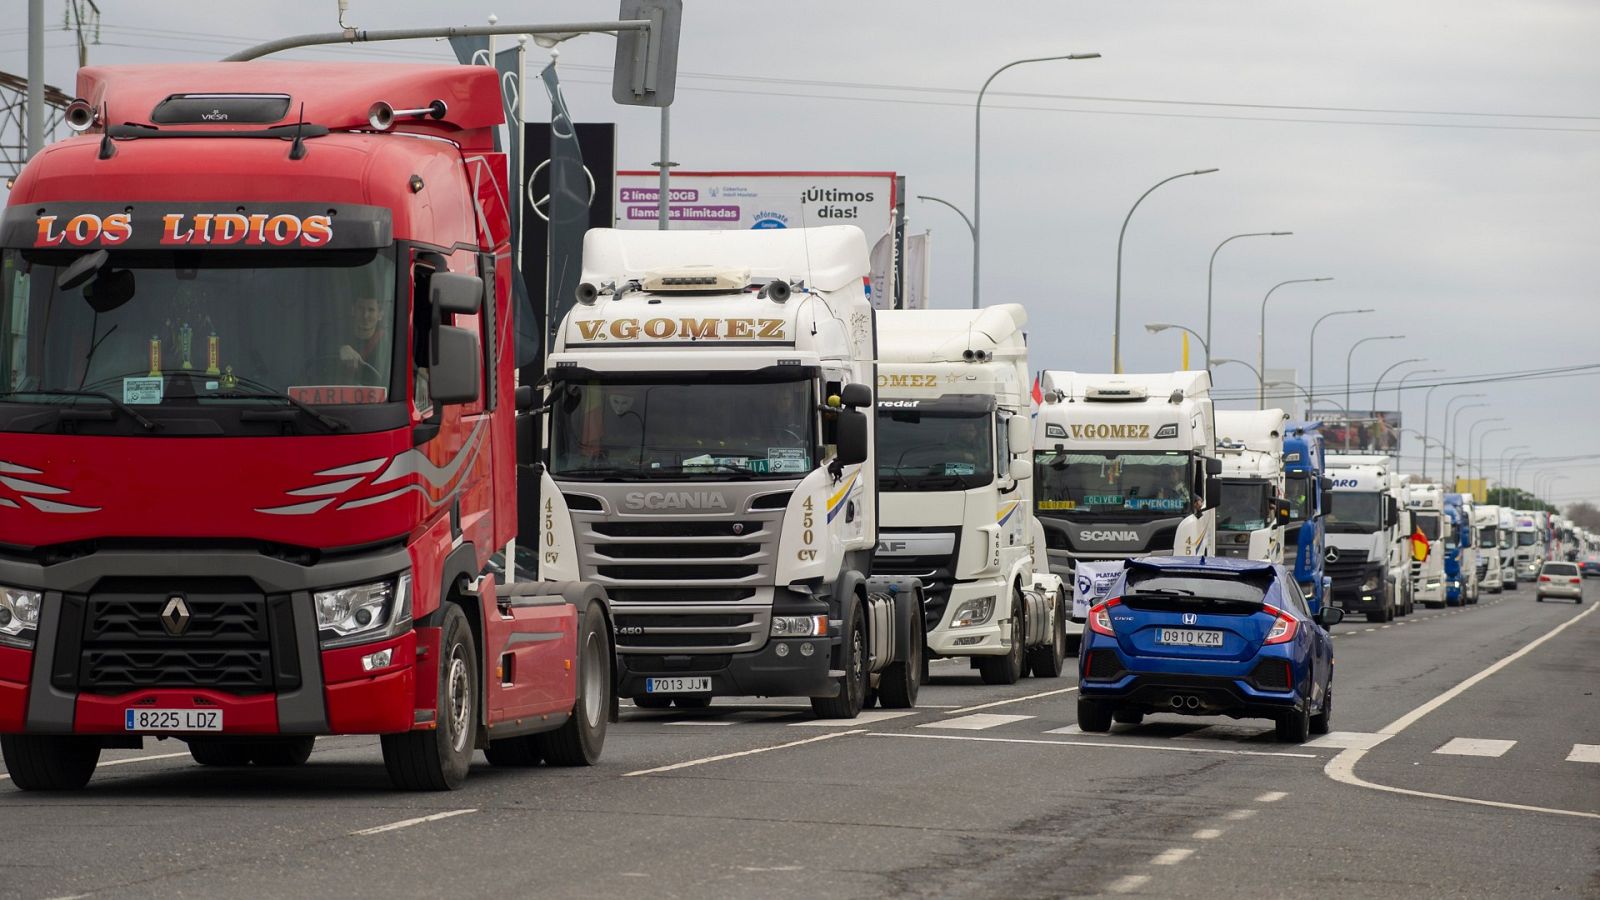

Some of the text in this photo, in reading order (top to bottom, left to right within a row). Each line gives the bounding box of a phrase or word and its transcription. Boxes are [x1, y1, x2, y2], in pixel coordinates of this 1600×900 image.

[622, 191, 629, 200] 2
[631, 190, 660, 201] línea
[801, 186, 874, 204] ¡Últimos
[631, 207, 737, 219] llamaas ilimitadas
[817, 205, 858, 219] días!
[33, 213, 334, 248] LOS LIDIOS
[575, 317, 786, 341] V.GOMEZ
[877, 374, 937, 388] OMEZ
[1071, 424, 1149, 438] V.GOMEZ
[1331, 479, 1358, 487] ARO
[624, 491, 728, 510] SCANIA
[1080, 530, 1140, 542] SCANIA
[878, 541, 906, 553] AF
[620, 626, 642, 634] 450
[1163, 630, 1220, 644] 0910 KZR
[654, 679, 684, 691] 7013
[139, 711, 180, 728] 8225
[186, 712, 217, 728] LDZ
